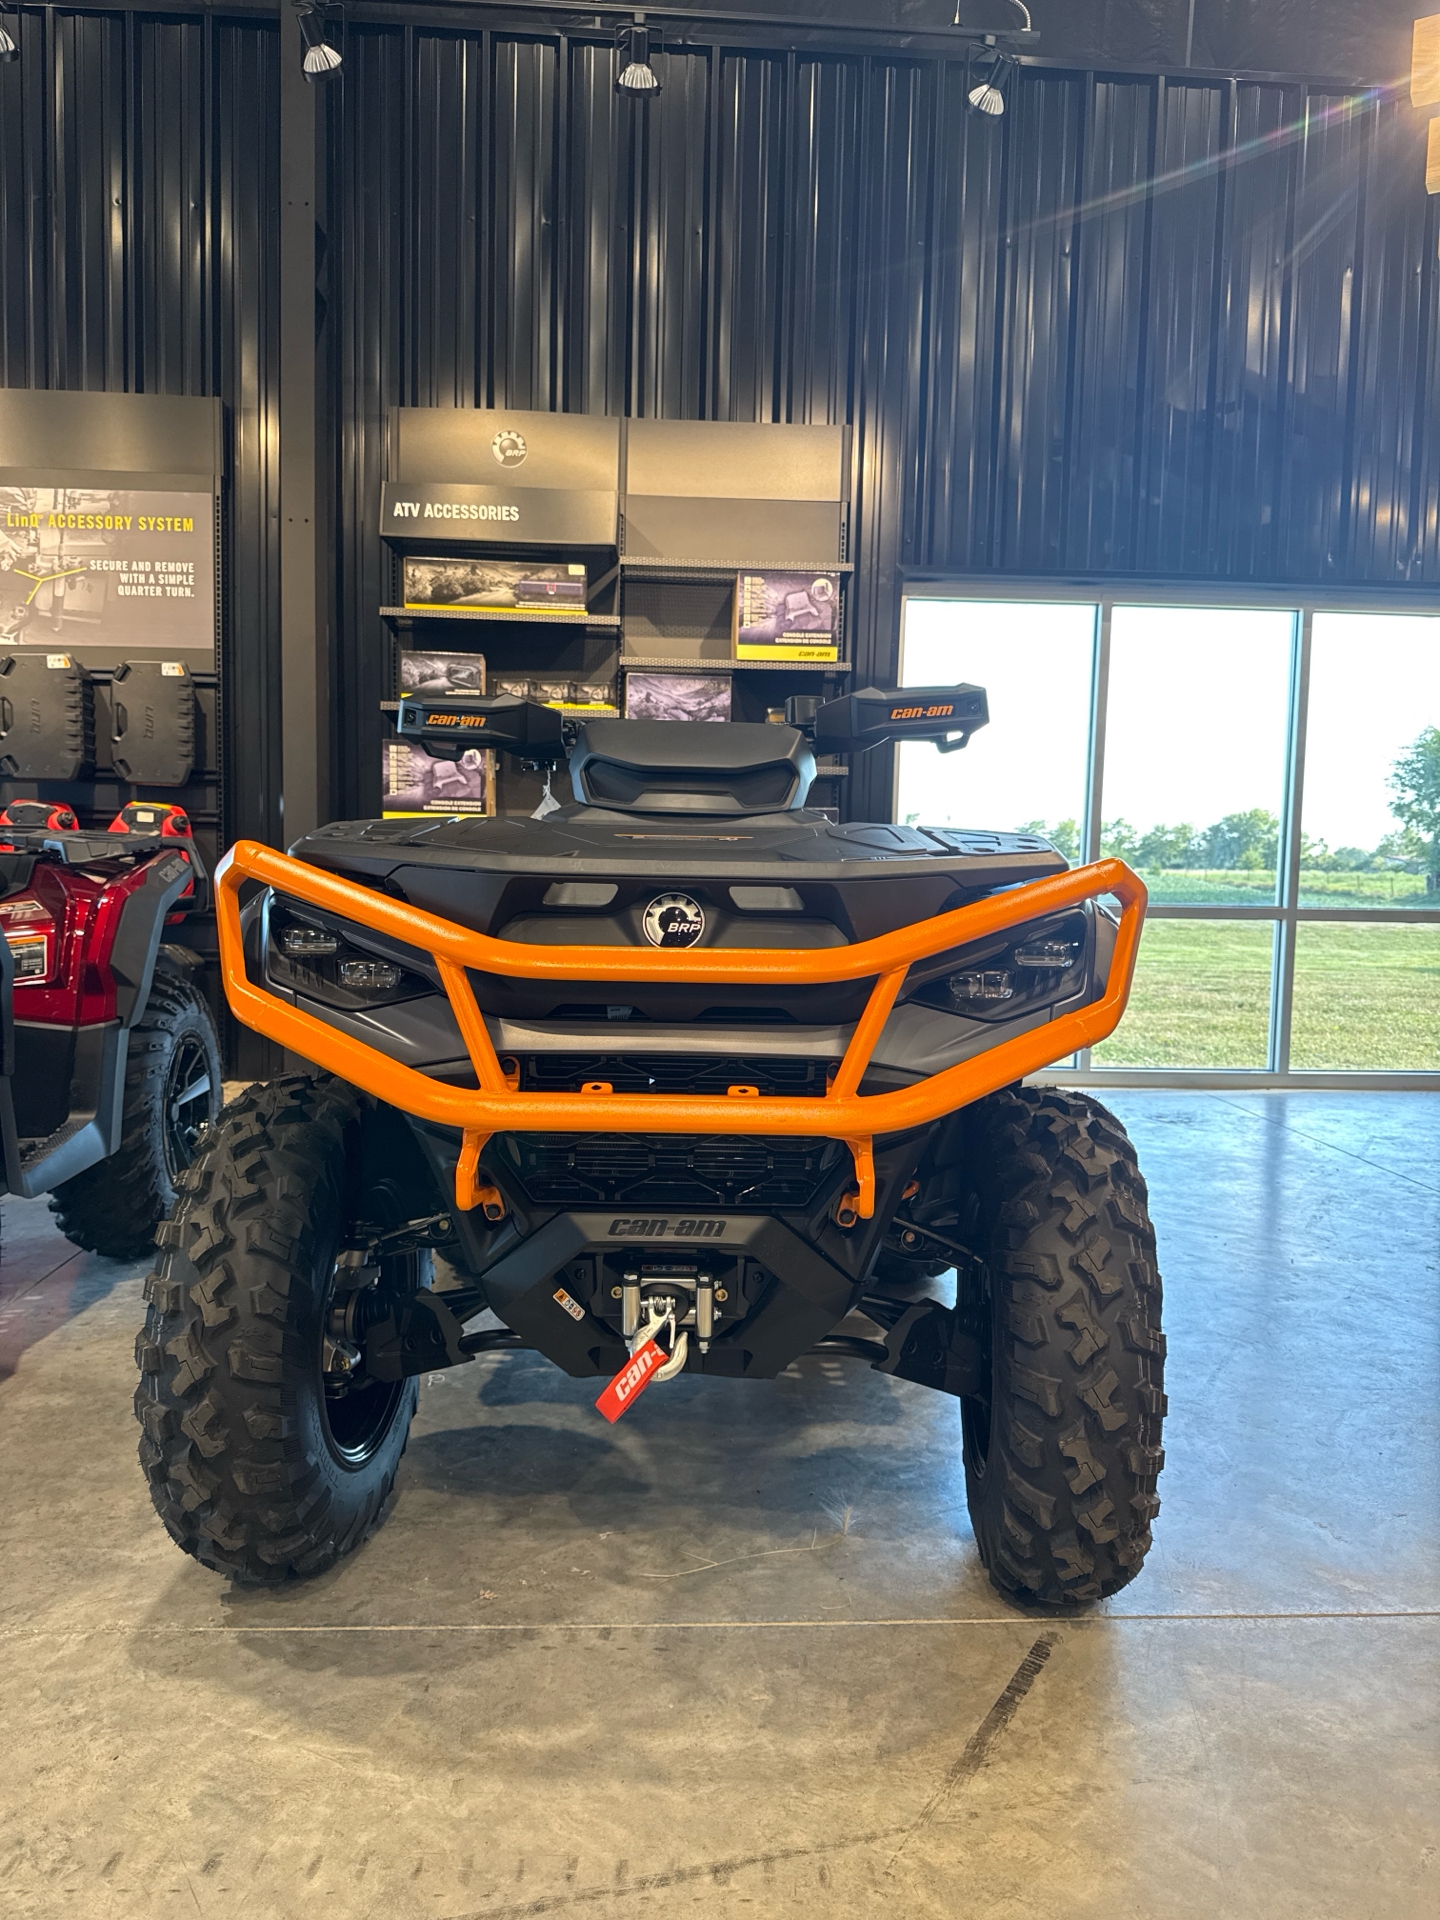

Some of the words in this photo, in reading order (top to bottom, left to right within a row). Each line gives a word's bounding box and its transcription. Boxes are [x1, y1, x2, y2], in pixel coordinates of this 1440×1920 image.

[505, 449, 526, 457] BRP
[393, 502, 420, 517] ATV
[424, 503, 519, 521] ACCESSORIES
[49, 514, 132, 530] ACCESSORY
[138, 517, 194, 532] SYSTEM
[90, 560, 128, 571] SECURE
[131, 561, 151, 572] AND
[155, 562, 194, 573] REMOVE
[120, 573, 145, 584] WITH
[149, 574, 155, 584] A
[158, 575, 194, 585] SIMPLE
[118, 586, 162, 597] QUARTER
[165, 587, 195, 597] TURN.
[890, 705, 954, 720] can-am
[428, 714, 486, 727] can-am
[667, 922, 701, 933] BRP
[608, 1219, 727, 1237] can-am
